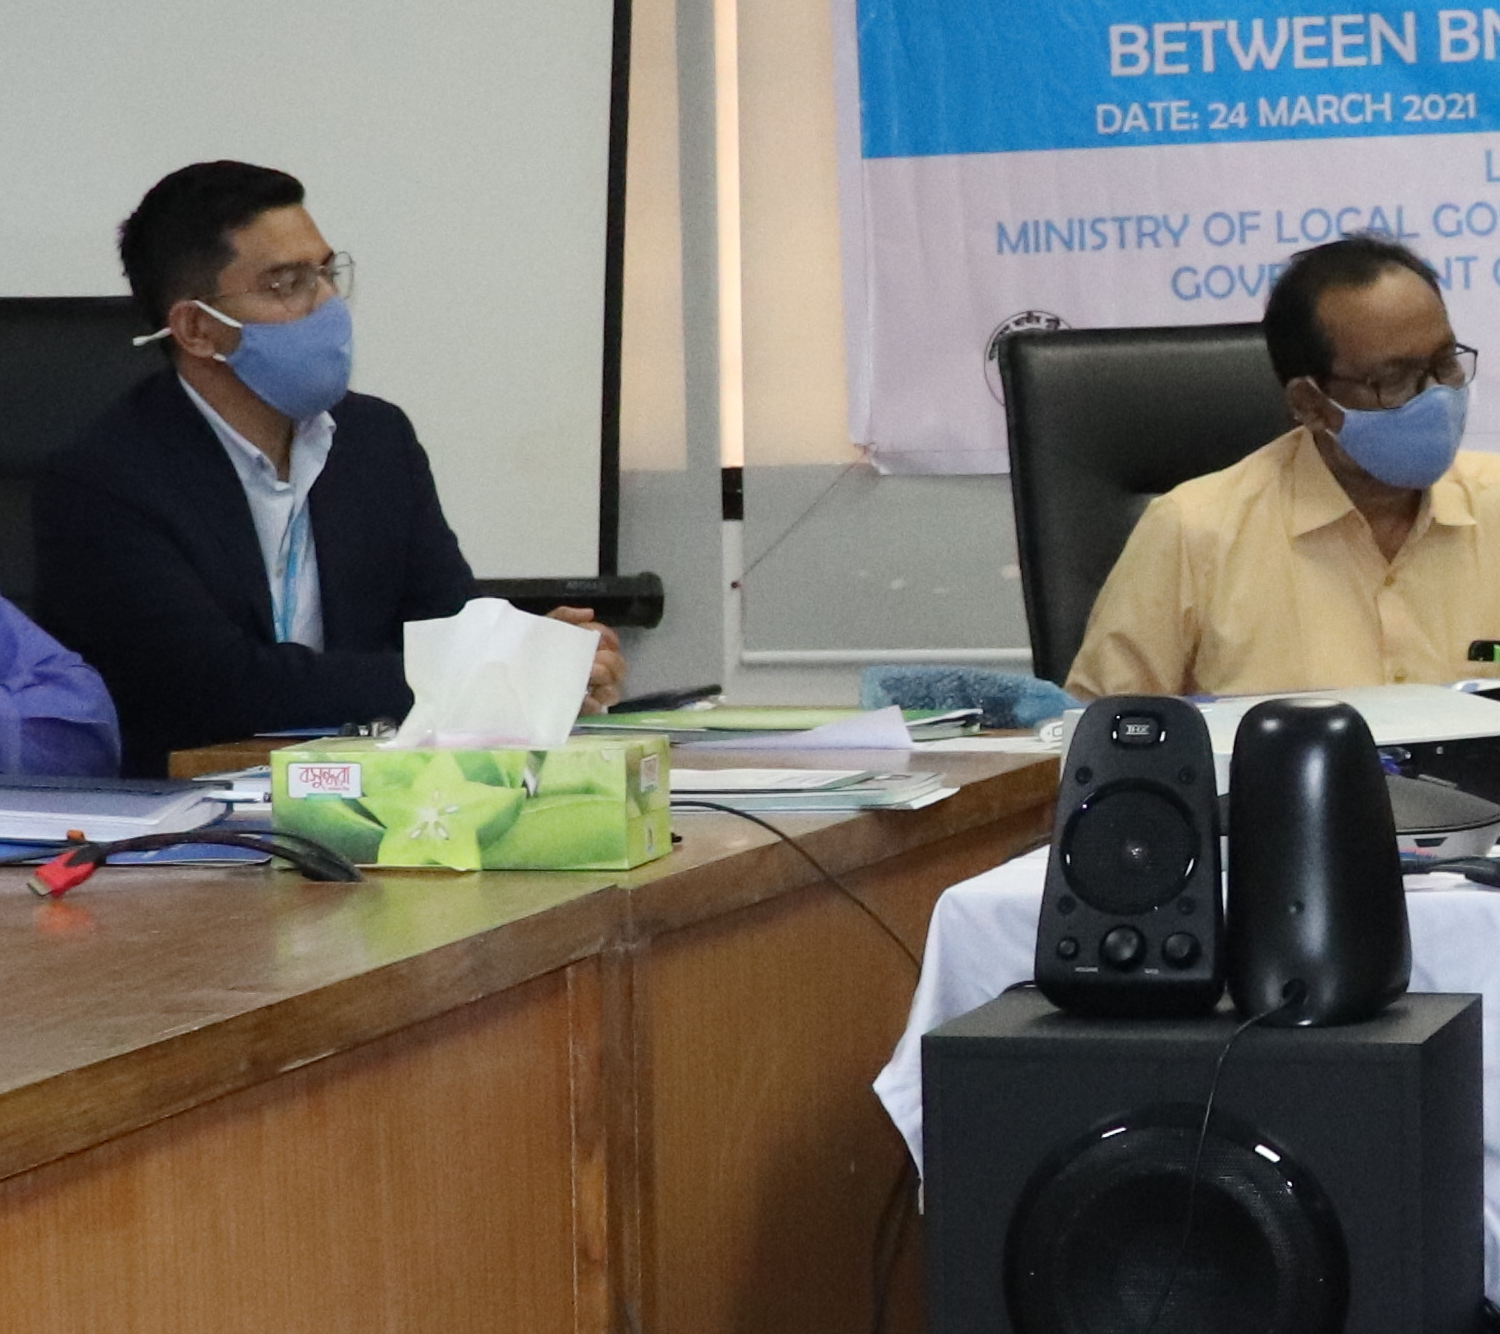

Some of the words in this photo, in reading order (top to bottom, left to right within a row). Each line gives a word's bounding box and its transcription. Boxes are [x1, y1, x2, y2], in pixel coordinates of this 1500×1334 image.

[1108, 10, 1418, 77] BETWEEN
[1096, 100, 1199, 134] DATE:
[1208, 102, 1248, 130] 24
[1259, 92, 1391, 129] MARCH
[1402, 92, 1477, 122] 2021
[996, 212, 1187, 255] MINISTRY
[1202, 210, 1261, 247] OF
[1276, 205, 1419, 244] LOCAL
